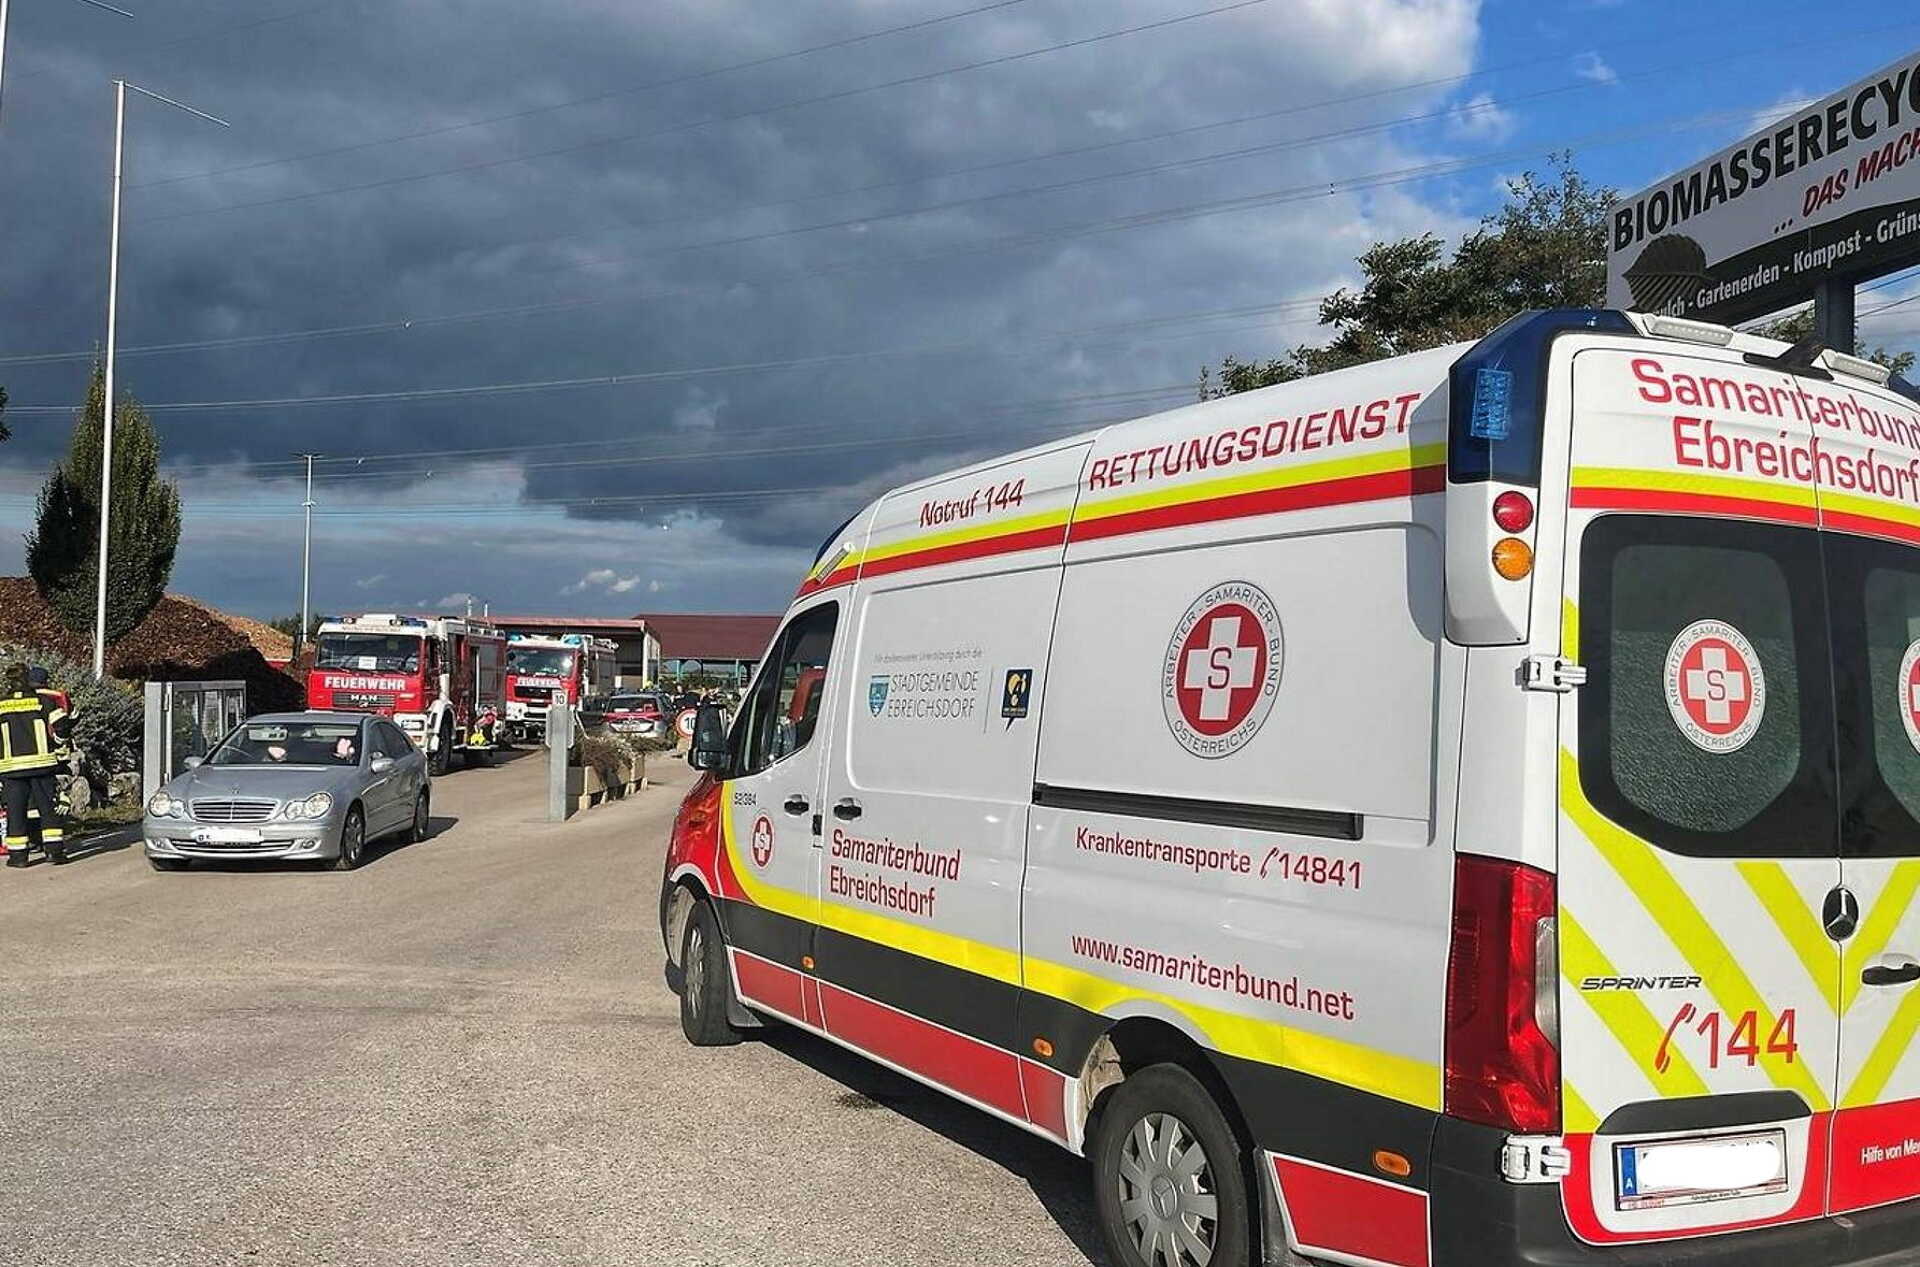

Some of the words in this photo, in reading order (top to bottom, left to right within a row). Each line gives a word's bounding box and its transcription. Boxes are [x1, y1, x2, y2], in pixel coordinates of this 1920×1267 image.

[1802, 168, 1850, 218] DAS
[1696, 265, 1780, 309] Gartenerden
[1793, 229, 1861, 274] Kompost
[1089, 392, 1422, 492] RETTUNGSDIENST
[1673, 415, 1920, 503] Ebreichsdorf
[919, 489, 981, 529] Notruf
[984, 478, 1025, 513] 144
[1165, 612, 1197, 699] ARBEITER
[1205, 586, 1274, 625] SAMARITER
[1264, 637, 1280, 697] BUND
[324, 676, 406, 691] FEUERWEHR
[891, 671, 979, 693] STADTGEMEINDE
[1207, 646, 1232, 690] S
[1706, 670, 1726, 701] S
[555, 694, 565, 705] 10
[888, 697, 977, 719] EBREICHSDORF
[832, 828, 962, 881] Samariterbund
[1076, 826, 1251, 874] Krankentransporte
[1278, 853, 1362, 890] 14841
[830, 865, 936, 918] Ebreichsdorf
[1072, 934, 1355, 1021] www.samariterbund.net
[1581, 976, 1702, 991] SPRINTER
[1697, 1008, 1798, 1069] 144
[1861, 1144, 1884, 1166] Hilfe
[1885, 1145, 1902, 1161] von
[1624, 1177, 1633, 1190] A
